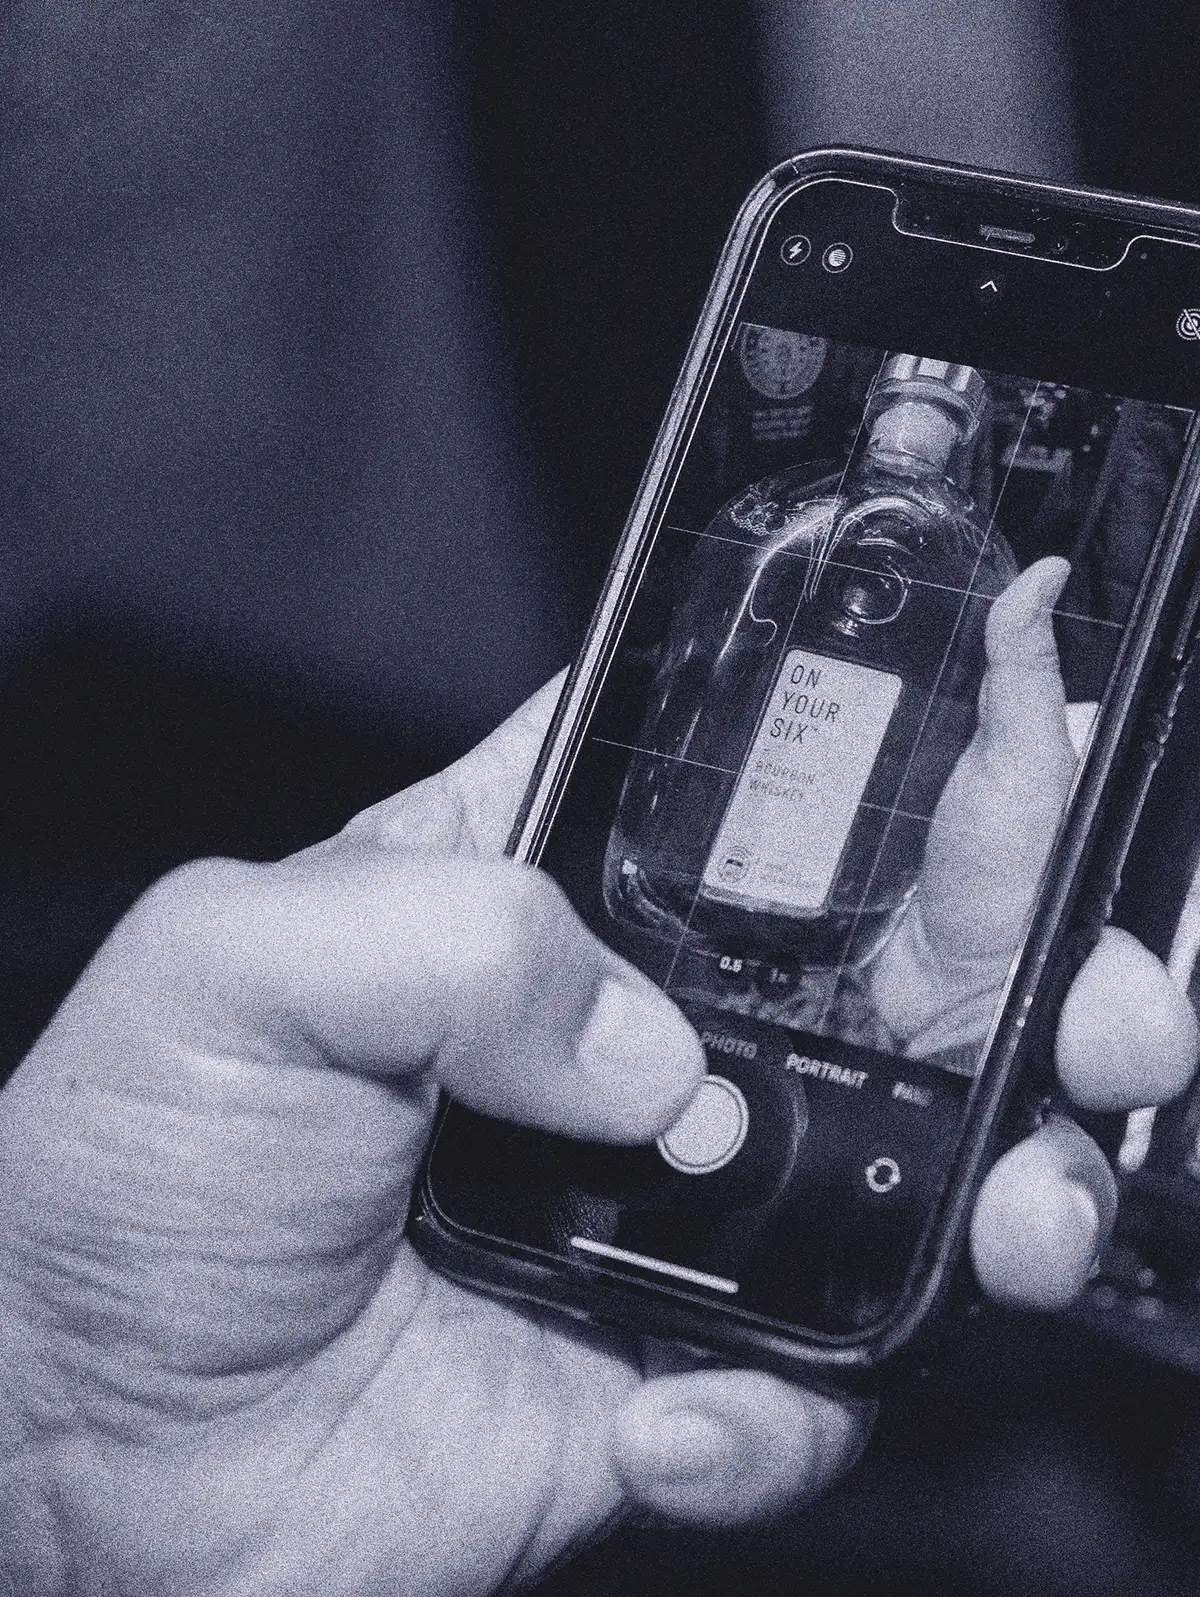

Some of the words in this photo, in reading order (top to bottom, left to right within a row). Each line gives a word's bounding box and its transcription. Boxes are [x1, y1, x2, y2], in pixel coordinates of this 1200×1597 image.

[790, 664, 822, 689] ON
[782, 691, 840, 722] YOUR
[770, 718, 808, 744] SIX
[701, 1031, 758, 1060] PHOTO
[785, 1053, 868, 1090] PORTRAIT
